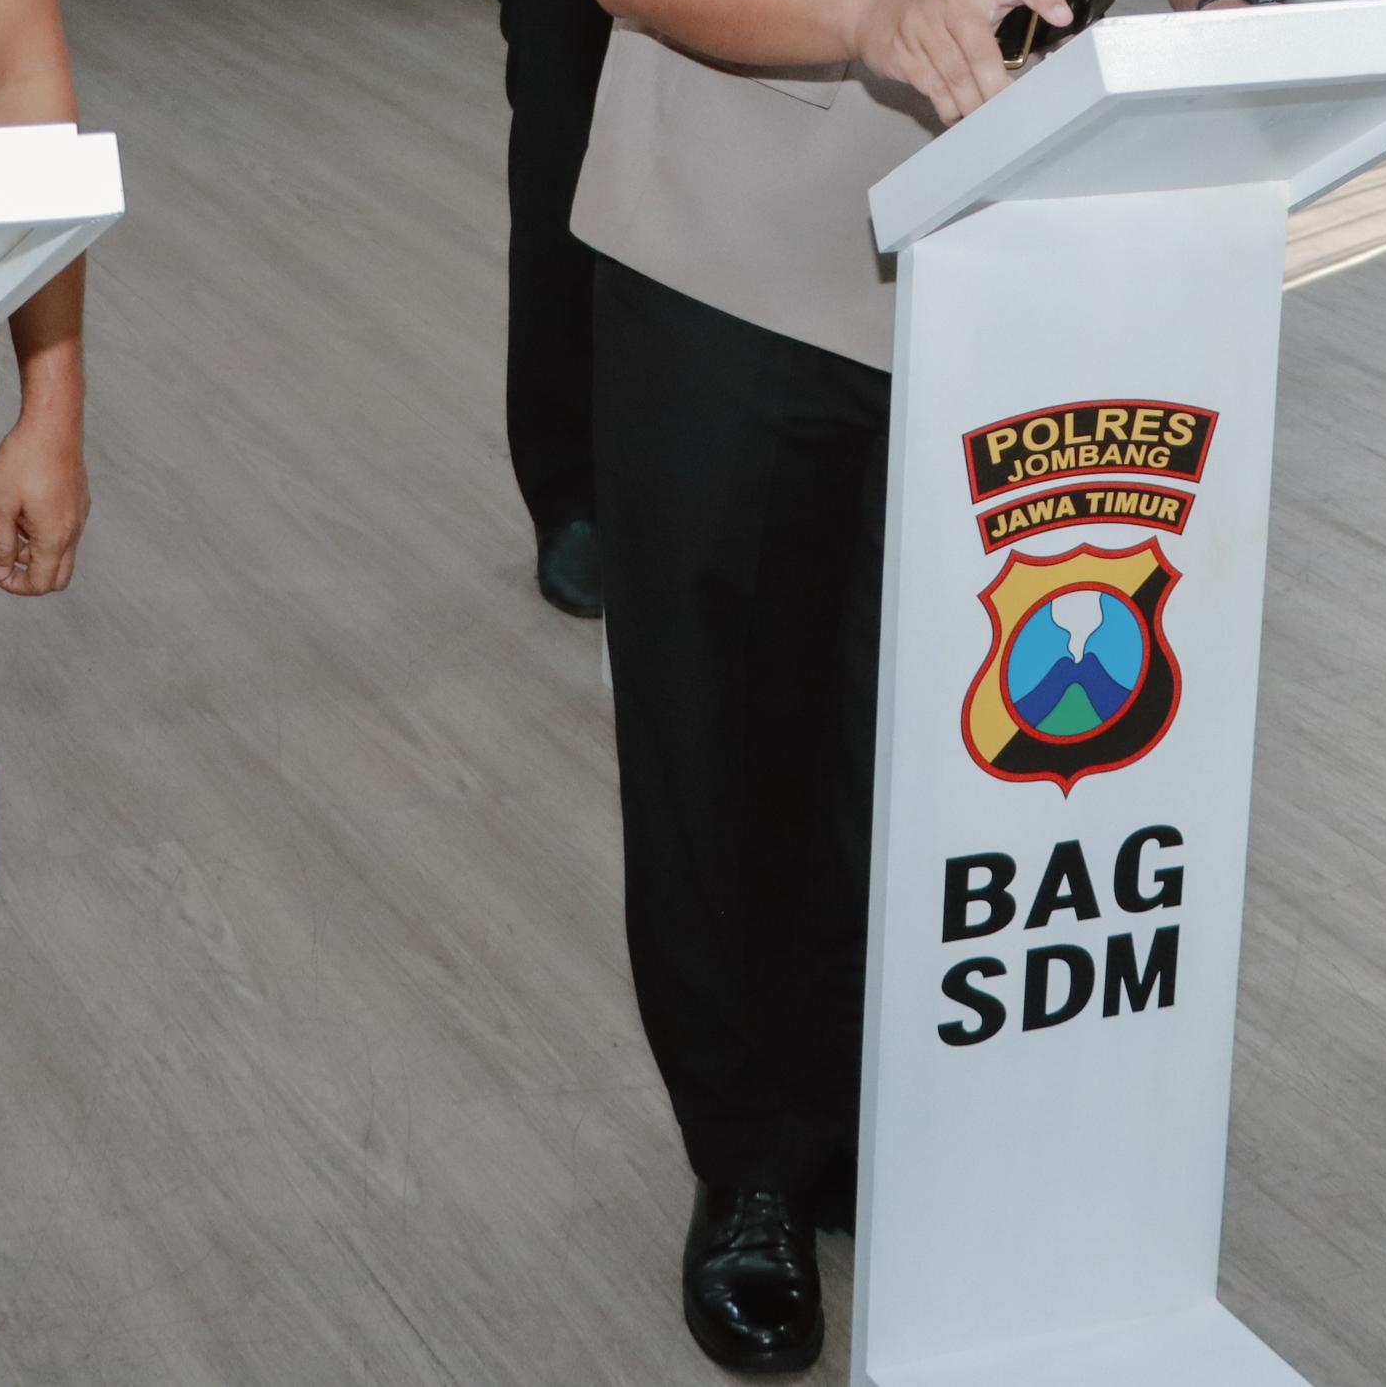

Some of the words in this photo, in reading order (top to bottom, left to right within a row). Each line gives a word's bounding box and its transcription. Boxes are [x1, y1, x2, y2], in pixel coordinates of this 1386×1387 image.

[986, 408, 1196, 464] POLRES
[1007, 443, 1171, 483] JOMBANG
[991, 495, 1077, 538] JAWA
[1085, 491, 1180, 522] TIMUR
[941, 824, 1185, 944] BAG
[937, 924, 1180, 1047] SDM
